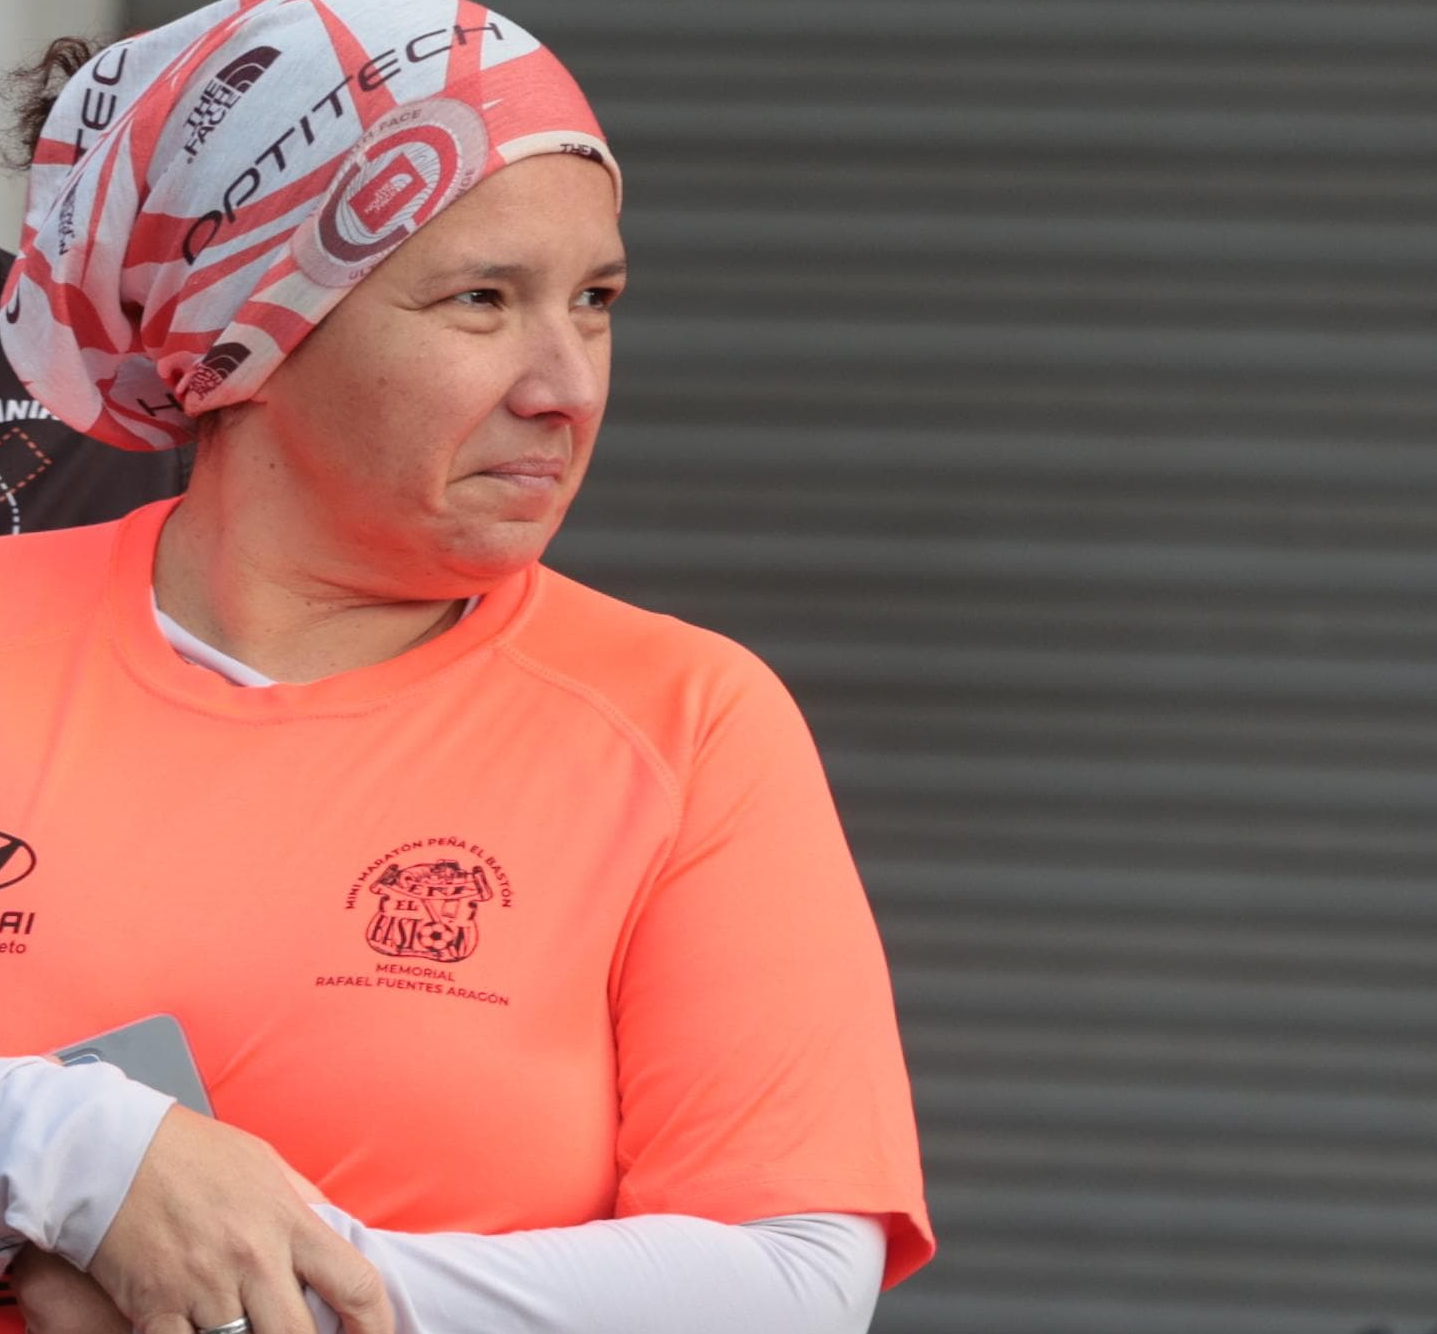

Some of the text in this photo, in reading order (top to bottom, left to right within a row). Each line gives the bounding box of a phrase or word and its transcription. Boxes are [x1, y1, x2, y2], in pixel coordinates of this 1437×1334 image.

[344, 883, 360, 910] MINI
[427, 836, 466, 849] PEÑA
[469, 845, 485, 858] EL
[376, 963, 456, 982] MEMORIAL
[315, 976, 509, 1006] RAFAEL FUENTES ARAGÓN
